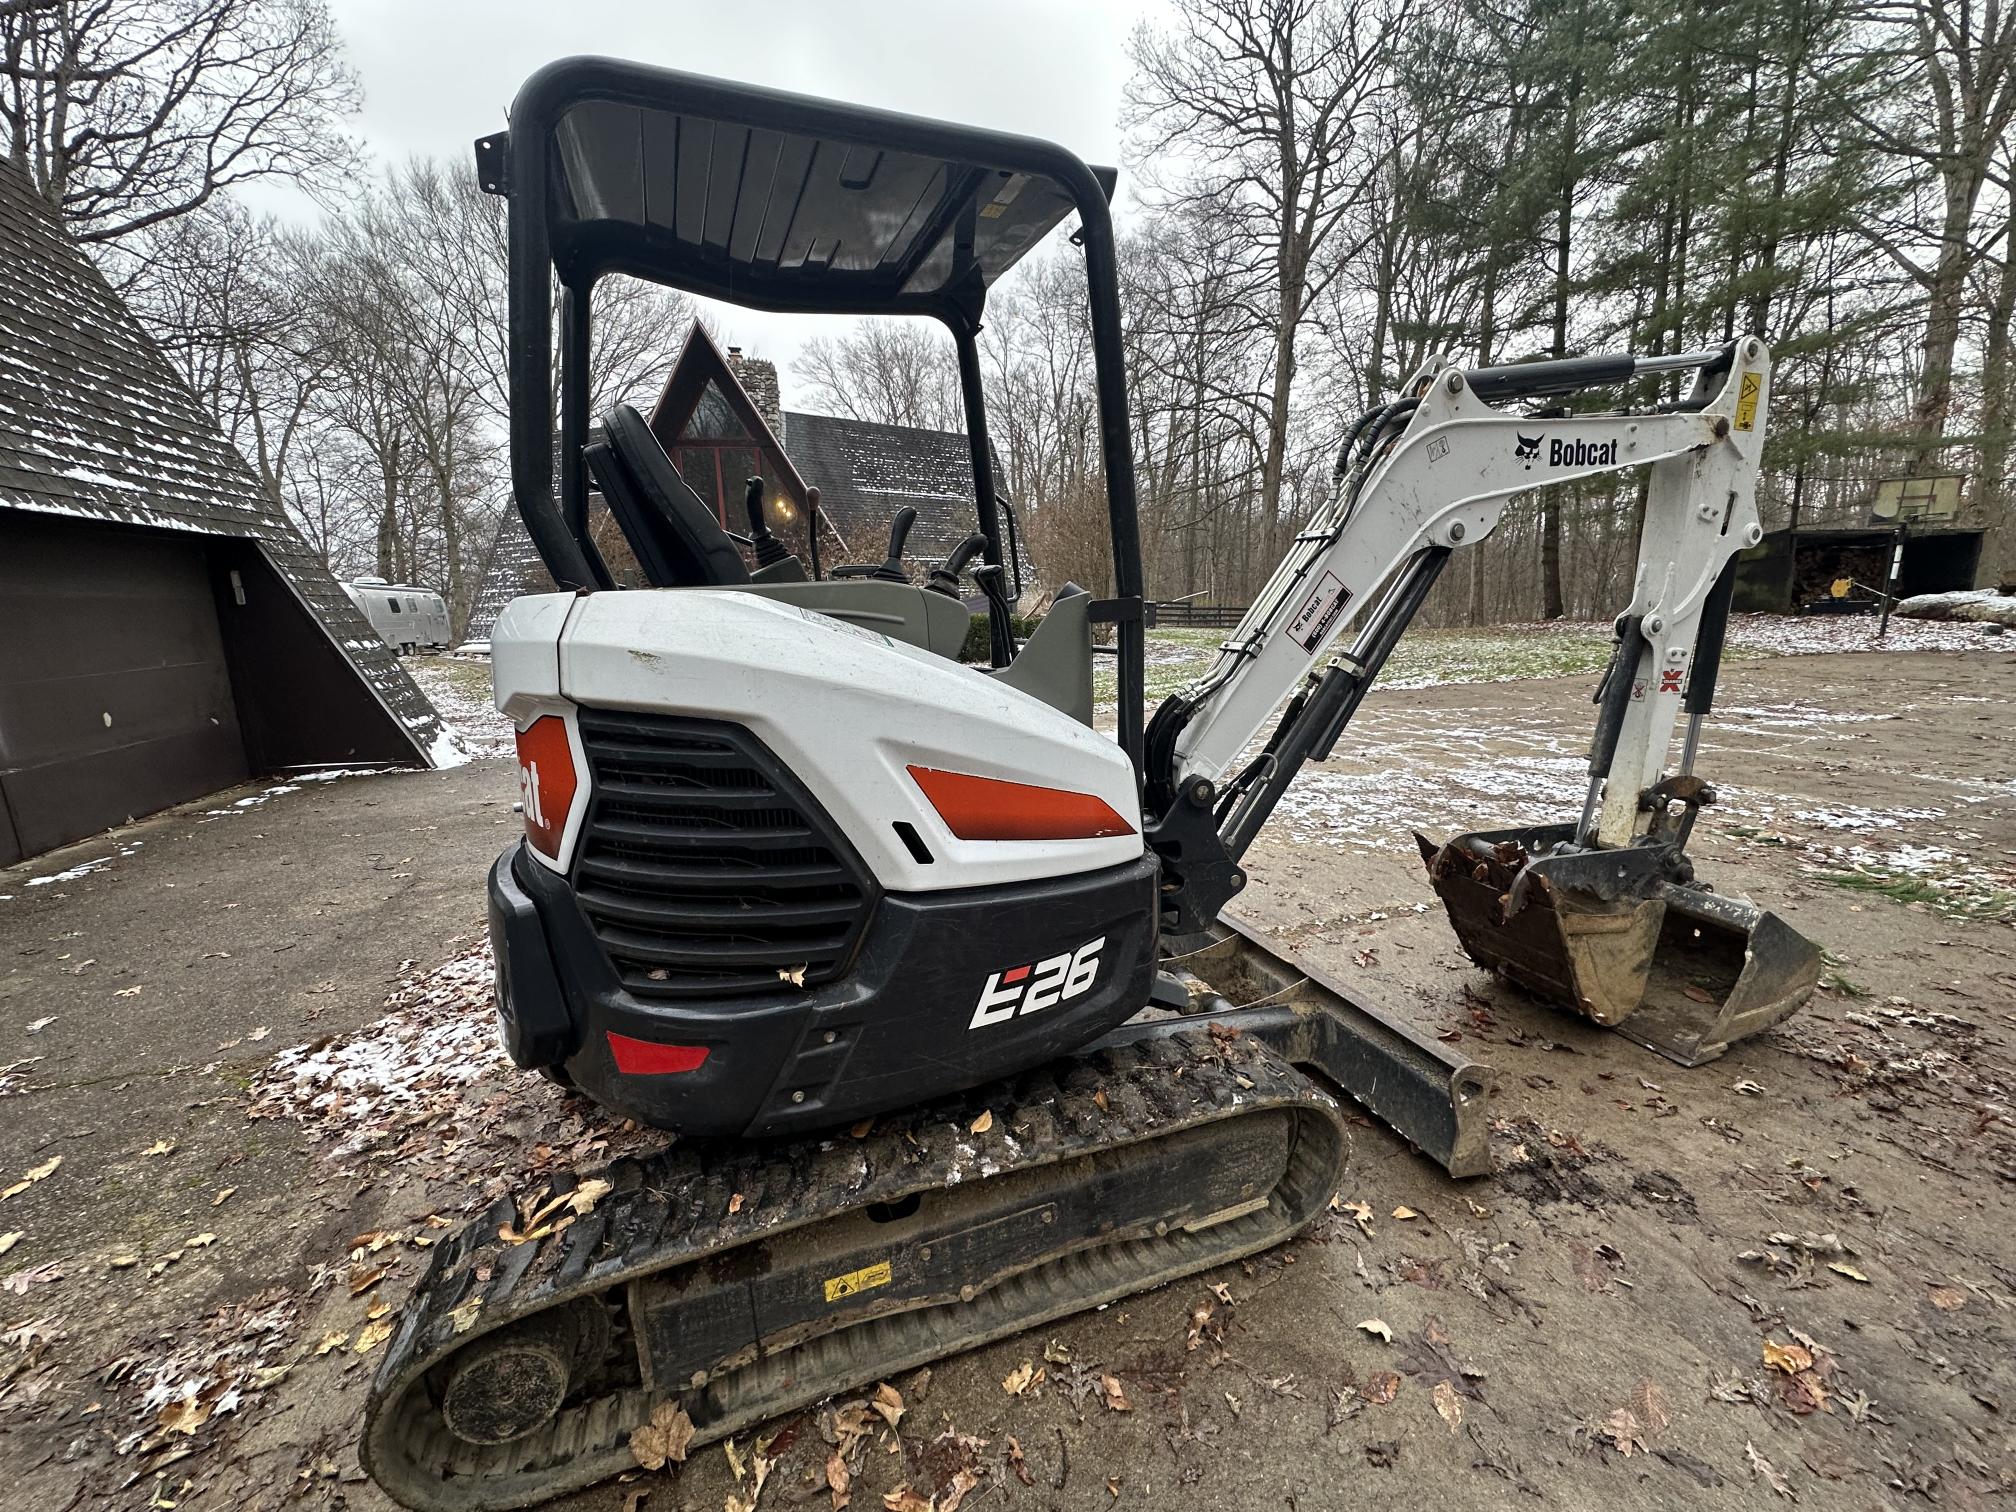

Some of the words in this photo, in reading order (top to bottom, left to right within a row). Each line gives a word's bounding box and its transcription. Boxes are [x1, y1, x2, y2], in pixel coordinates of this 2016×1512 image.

[1550, 438, 1617, 467] Bobcat
[1301, 596, 1322, 622] Bobcat
[521, 760, 544, 828] at
[968, 936, 1106, 1030] E26
